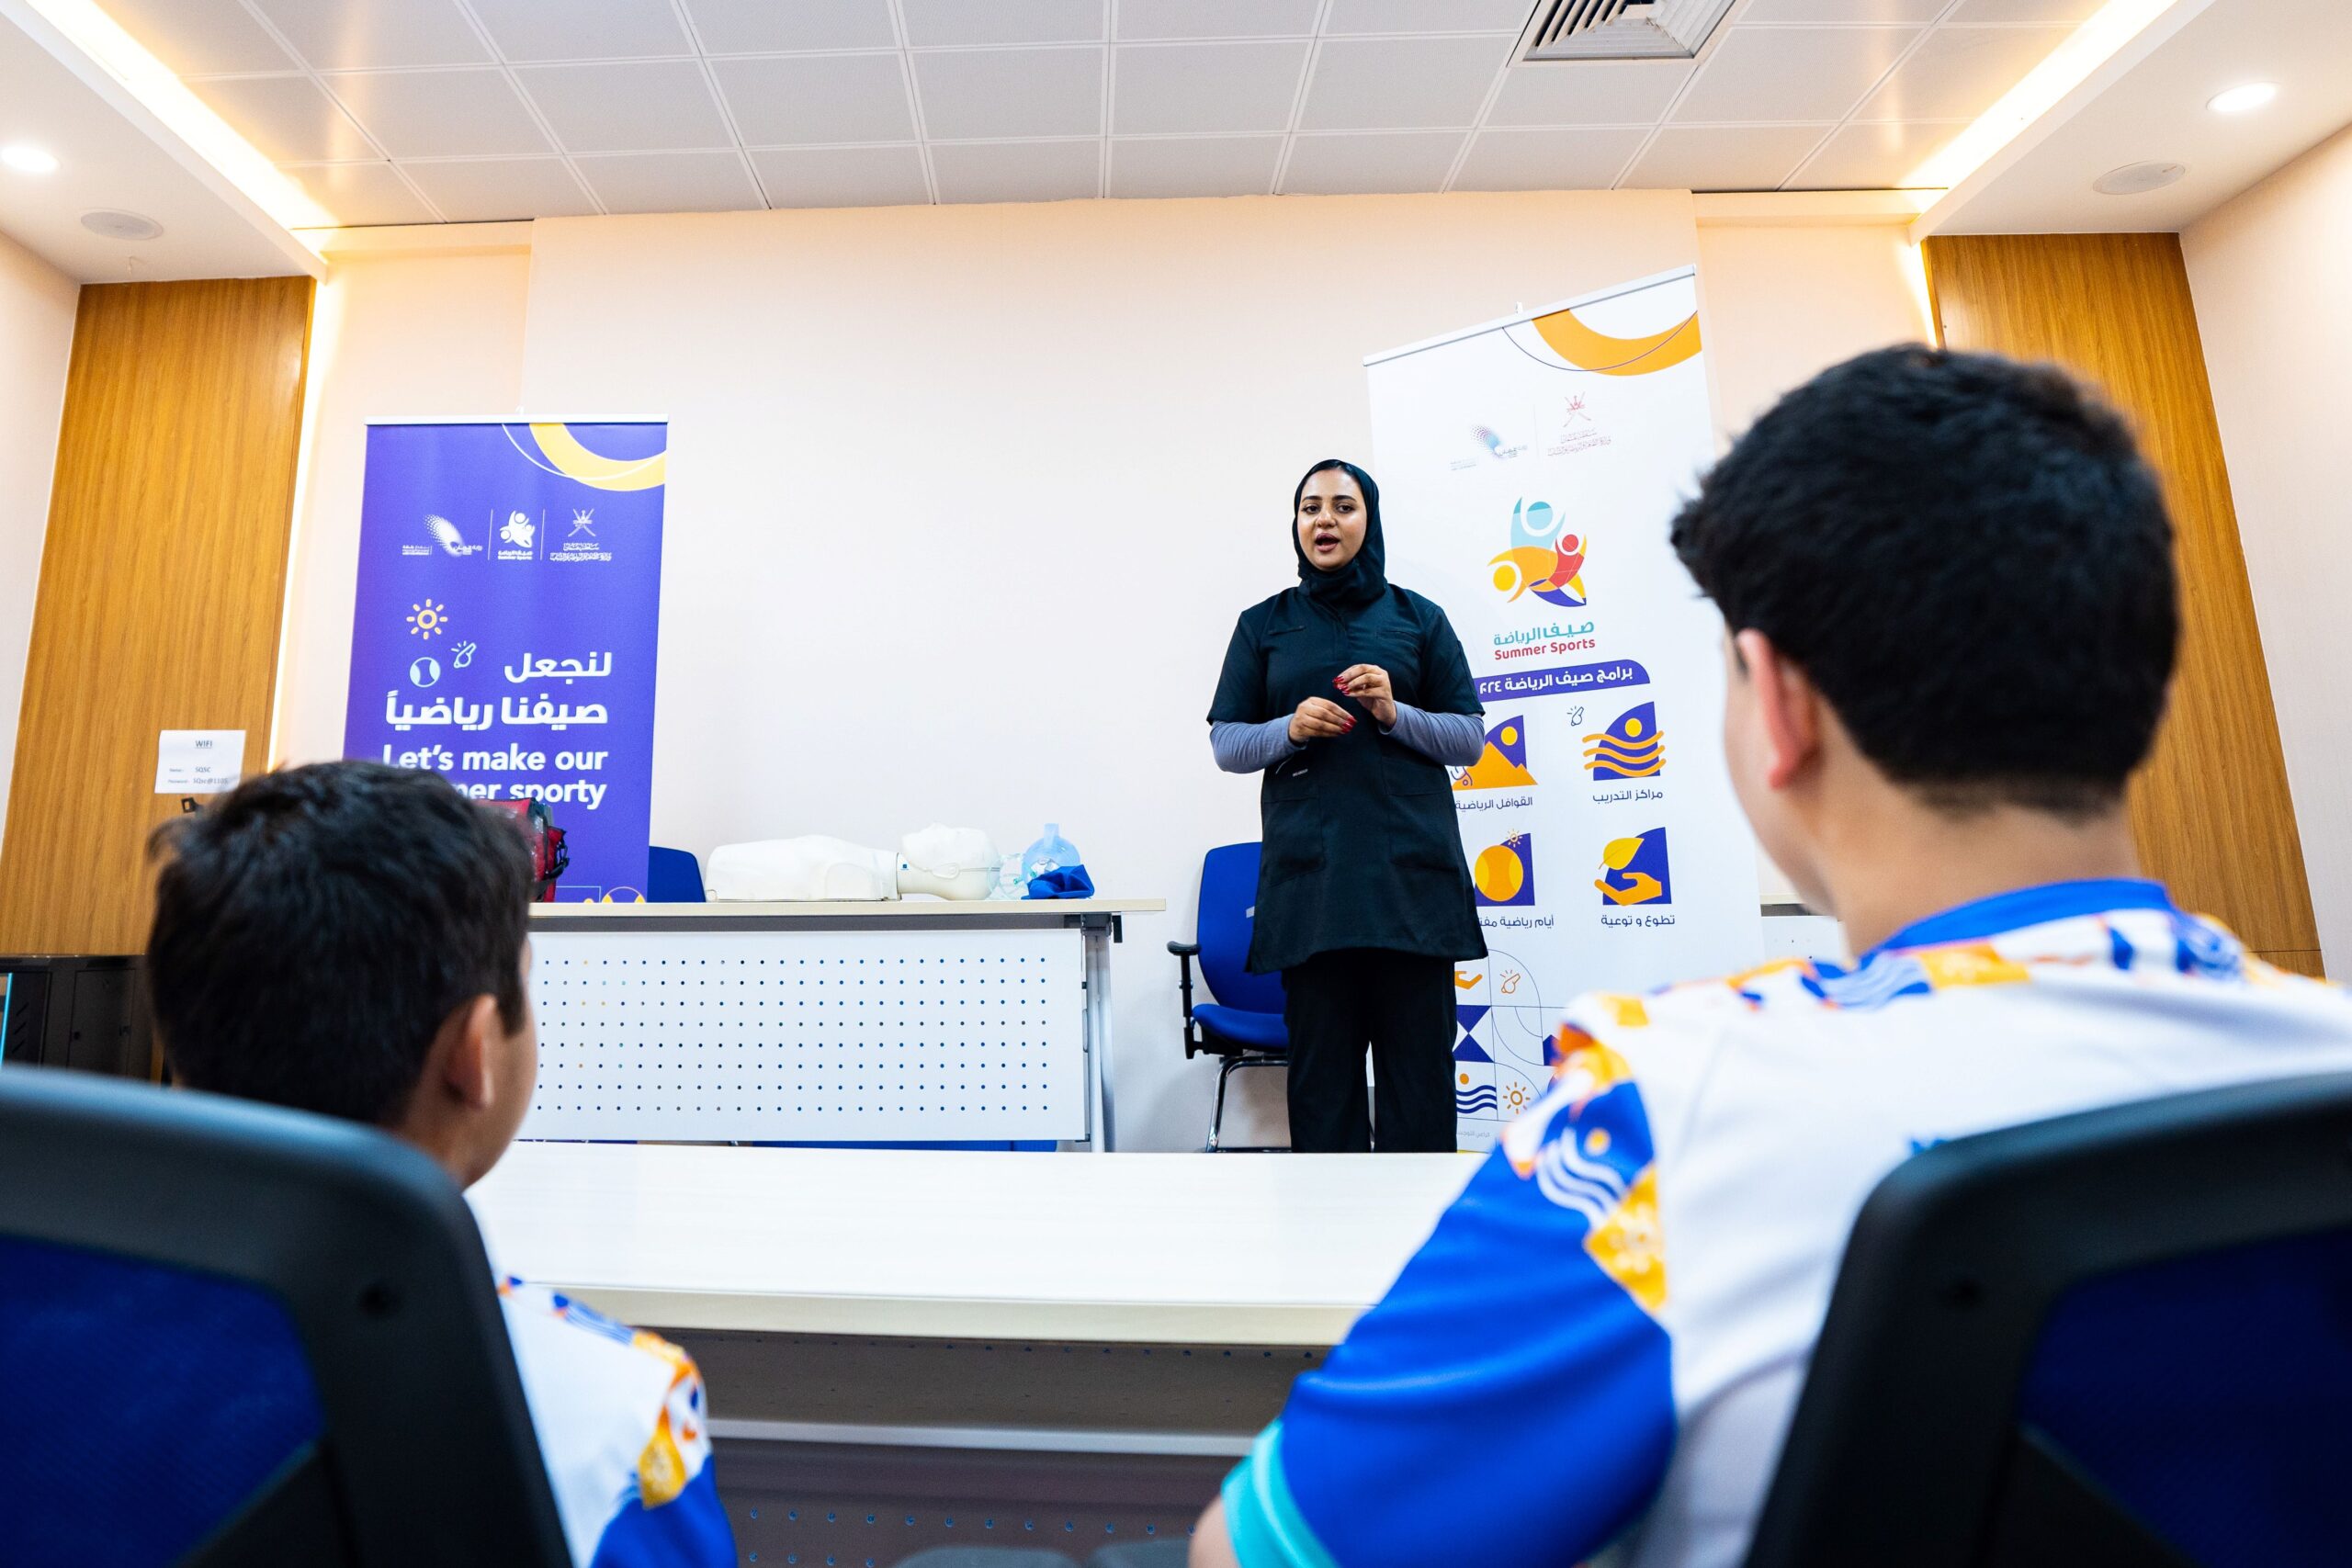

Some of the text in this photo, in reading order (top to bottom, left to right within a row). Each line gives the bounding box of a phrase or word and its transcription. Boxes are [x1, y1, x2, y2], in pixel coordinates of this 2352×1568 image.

[1493, 621, 1595, 646] صيف الرياضة
[1494, 638, 1596, 660] Summer Sports
[504, 651, 612, 685] لنجعل
[1596, 666, 1634, 683] برامج
[1504, 674, 1553, 691] الرياضة
[1555, 671, 1594, 687] صيف
[385, 690, 608, 731] صيفنا رياضياً
[383, 742, 608, 771] Let's make our
[509, 779, 607, 810] sporty
[1592, 789, 1664, 805] مراكز التدريب
[1455, 796, 1533, 813] القوافل الرياضية
[1499, 916, 1532, 930] رياضية
[1534, 914, 1555, 929] أيام
[1600, 914, 1676, 929] تطوع و توعية
